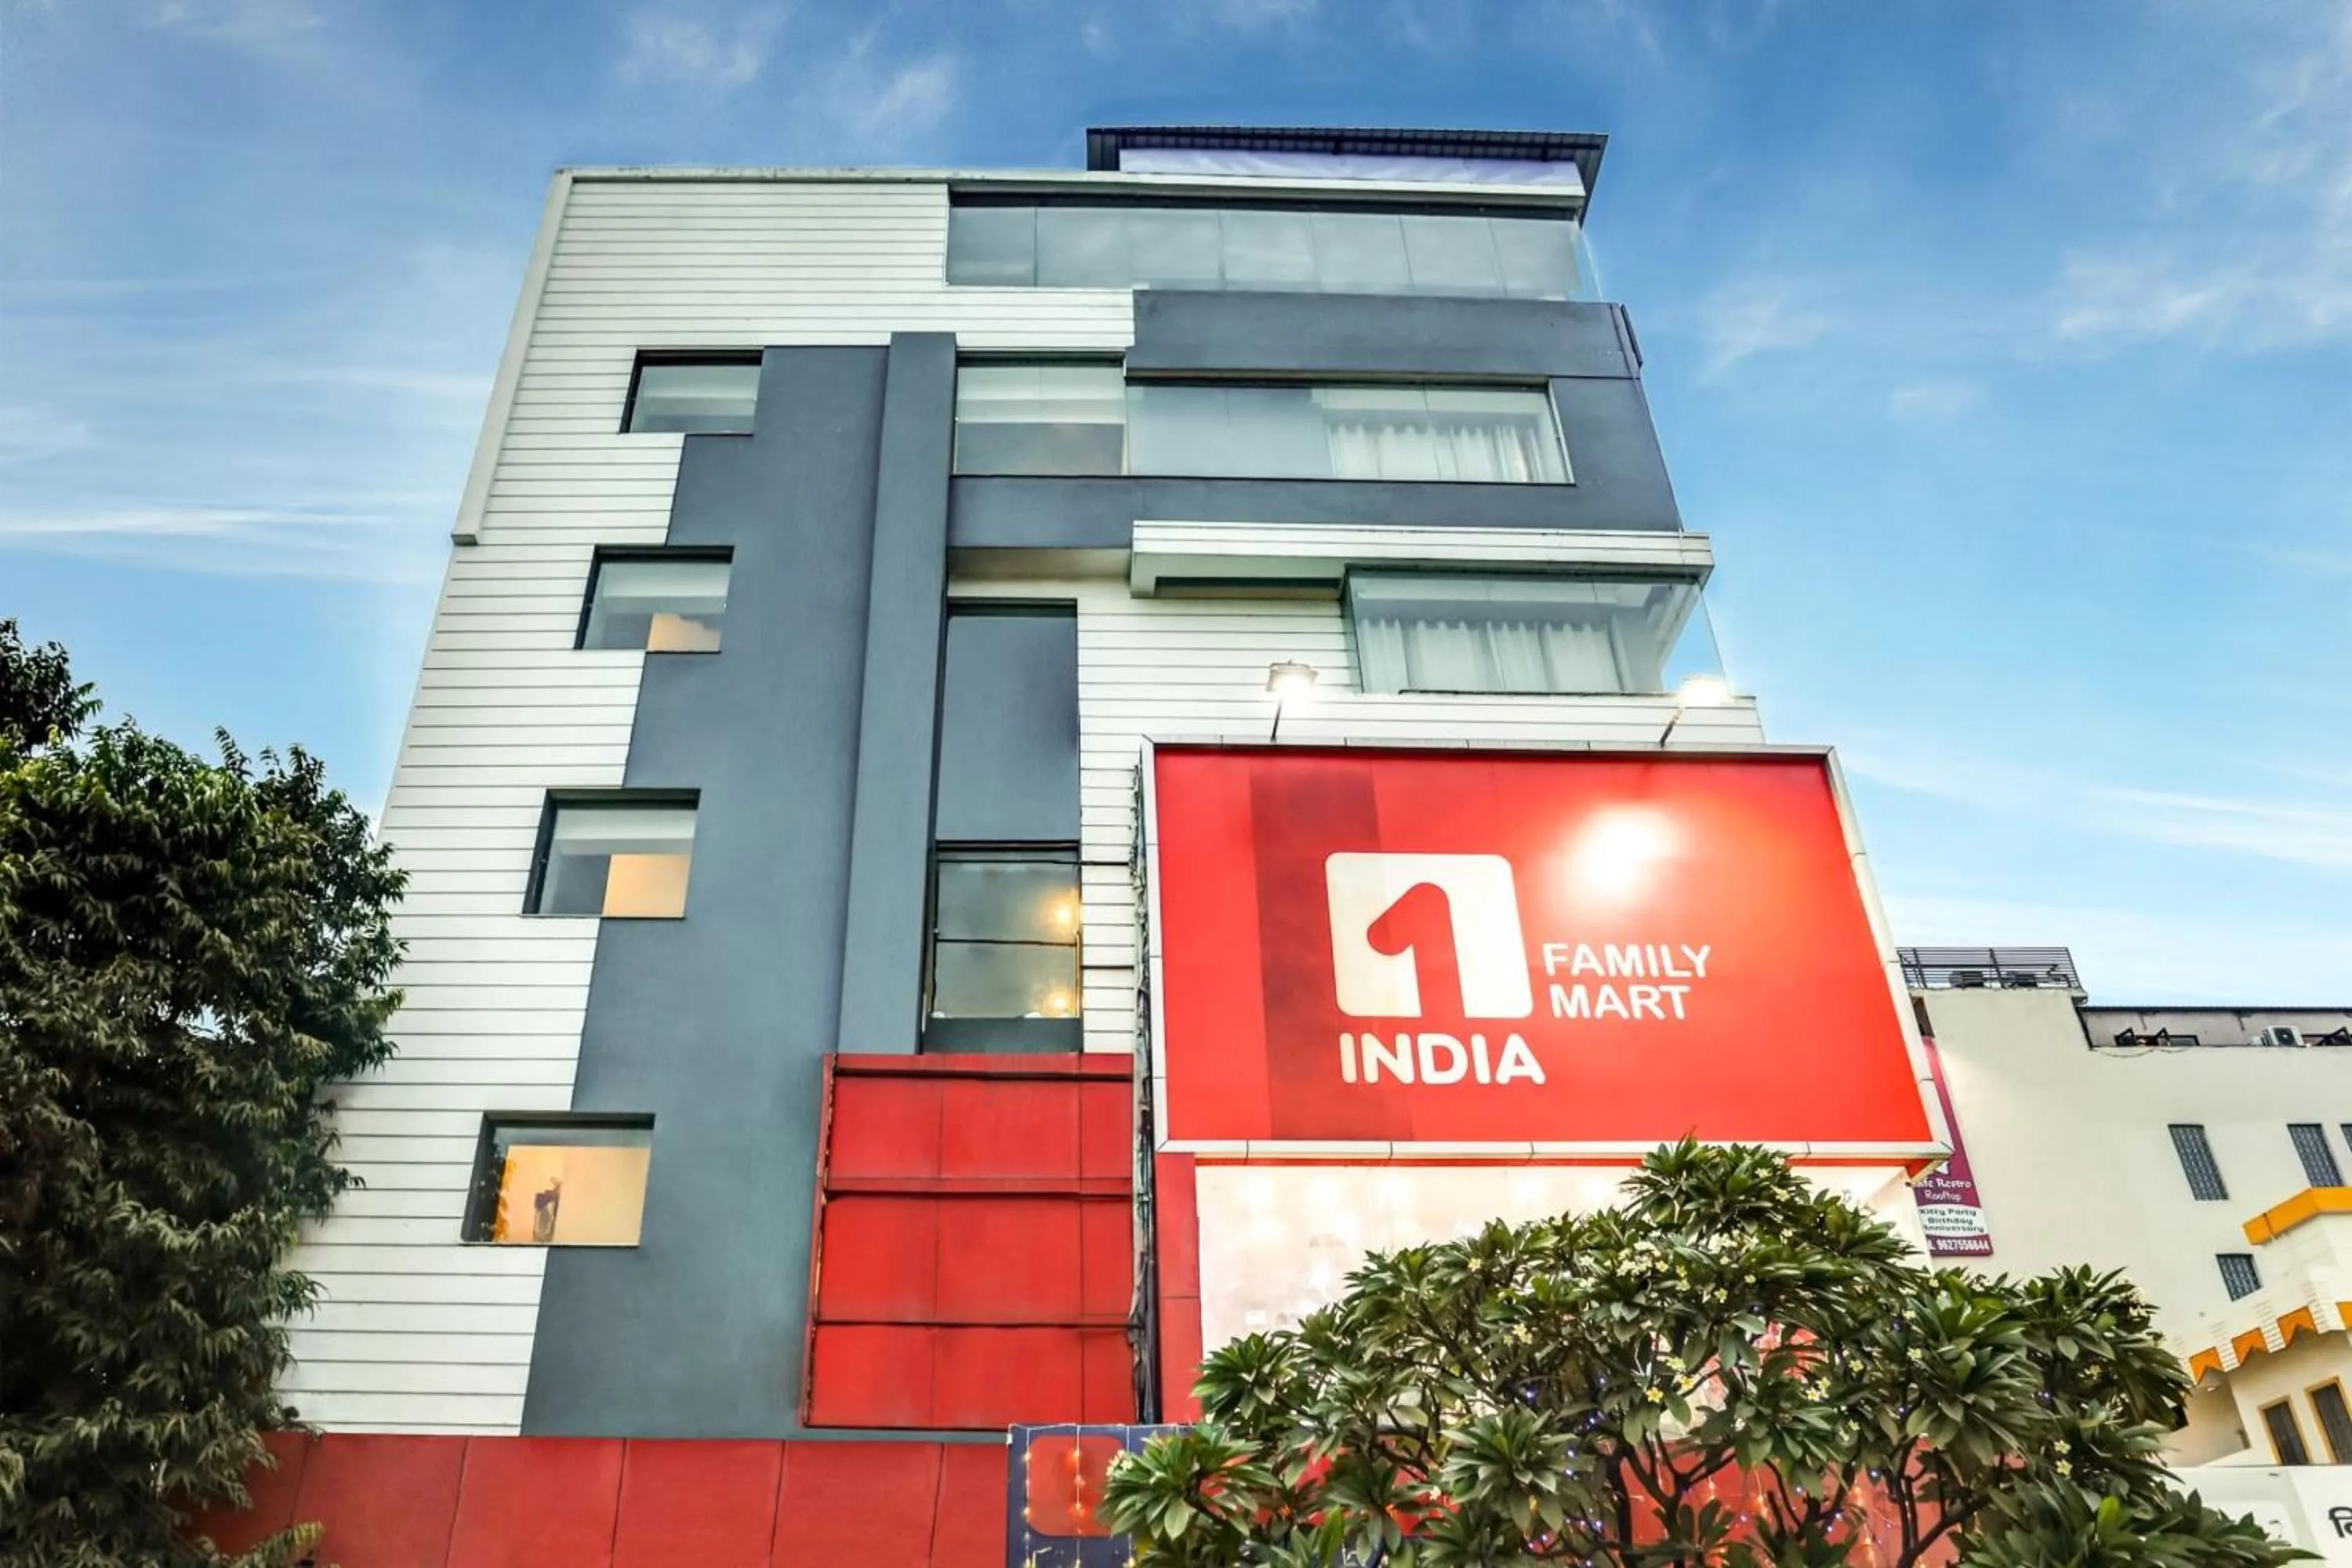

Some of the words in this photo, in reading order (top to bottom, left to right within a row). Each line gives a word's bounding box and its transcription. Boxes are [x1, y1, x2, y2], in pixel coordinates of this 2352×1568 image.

[1542, 943, 1711, 978] FAMILY
[1548, 984, 1691, 1019] MART
[1339, 1033, 1546, 1084] INDIA
[1936, 1178, 1972, 1189] Restro
[1928, 1217, 1973, 1225] Birthday
[1947, 1208, 1976, 1217] Party
